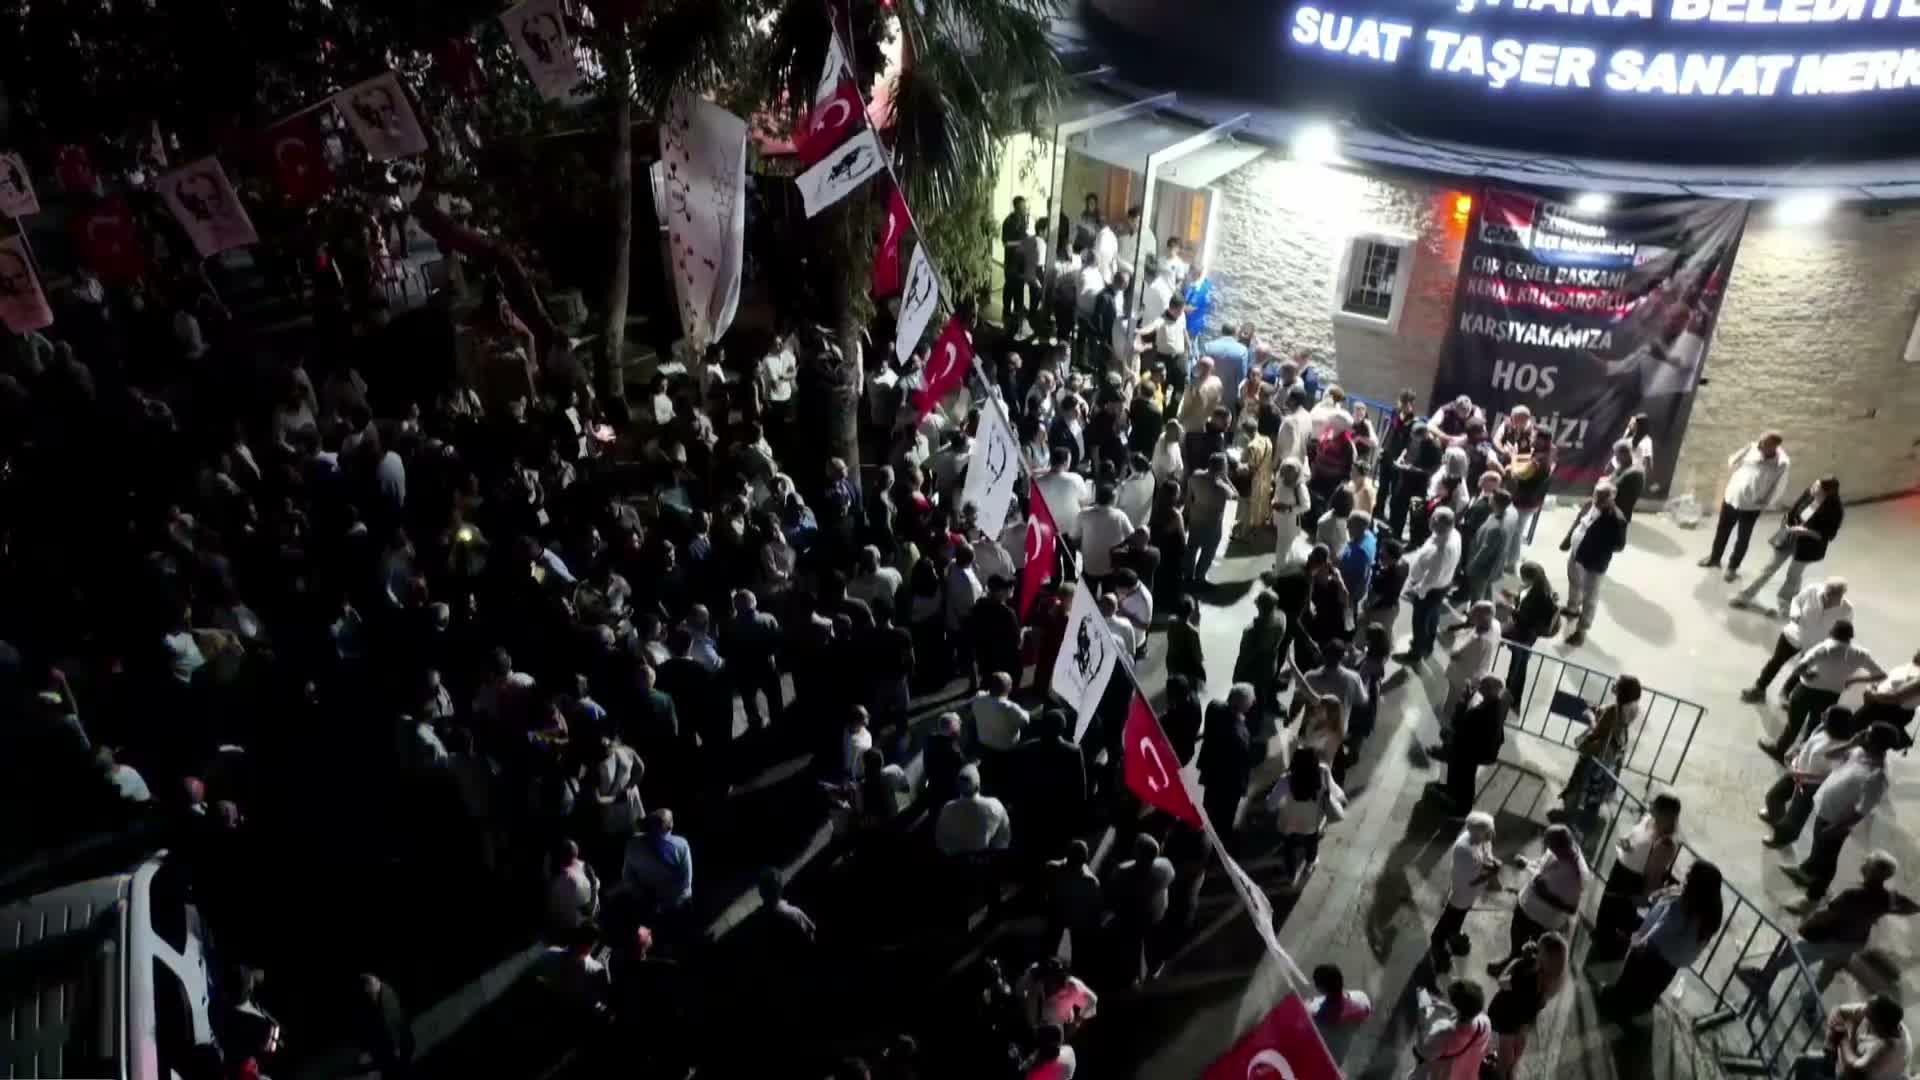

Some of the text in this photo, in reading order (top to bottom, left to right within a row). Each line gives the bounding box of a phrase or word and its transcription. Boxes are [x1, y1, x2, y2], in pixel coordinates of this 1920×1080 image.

[1292, 7, 1412, 62] SUAT
[1426, 29, 1596, 88] TAŞER
[1605, 50, 1793, 95] SANAT
[1472, 255, 1502, 275] CHP
[1505, 261, 1551, 284] GENEL
[1491, 359, 1559, 398] HOŞ
